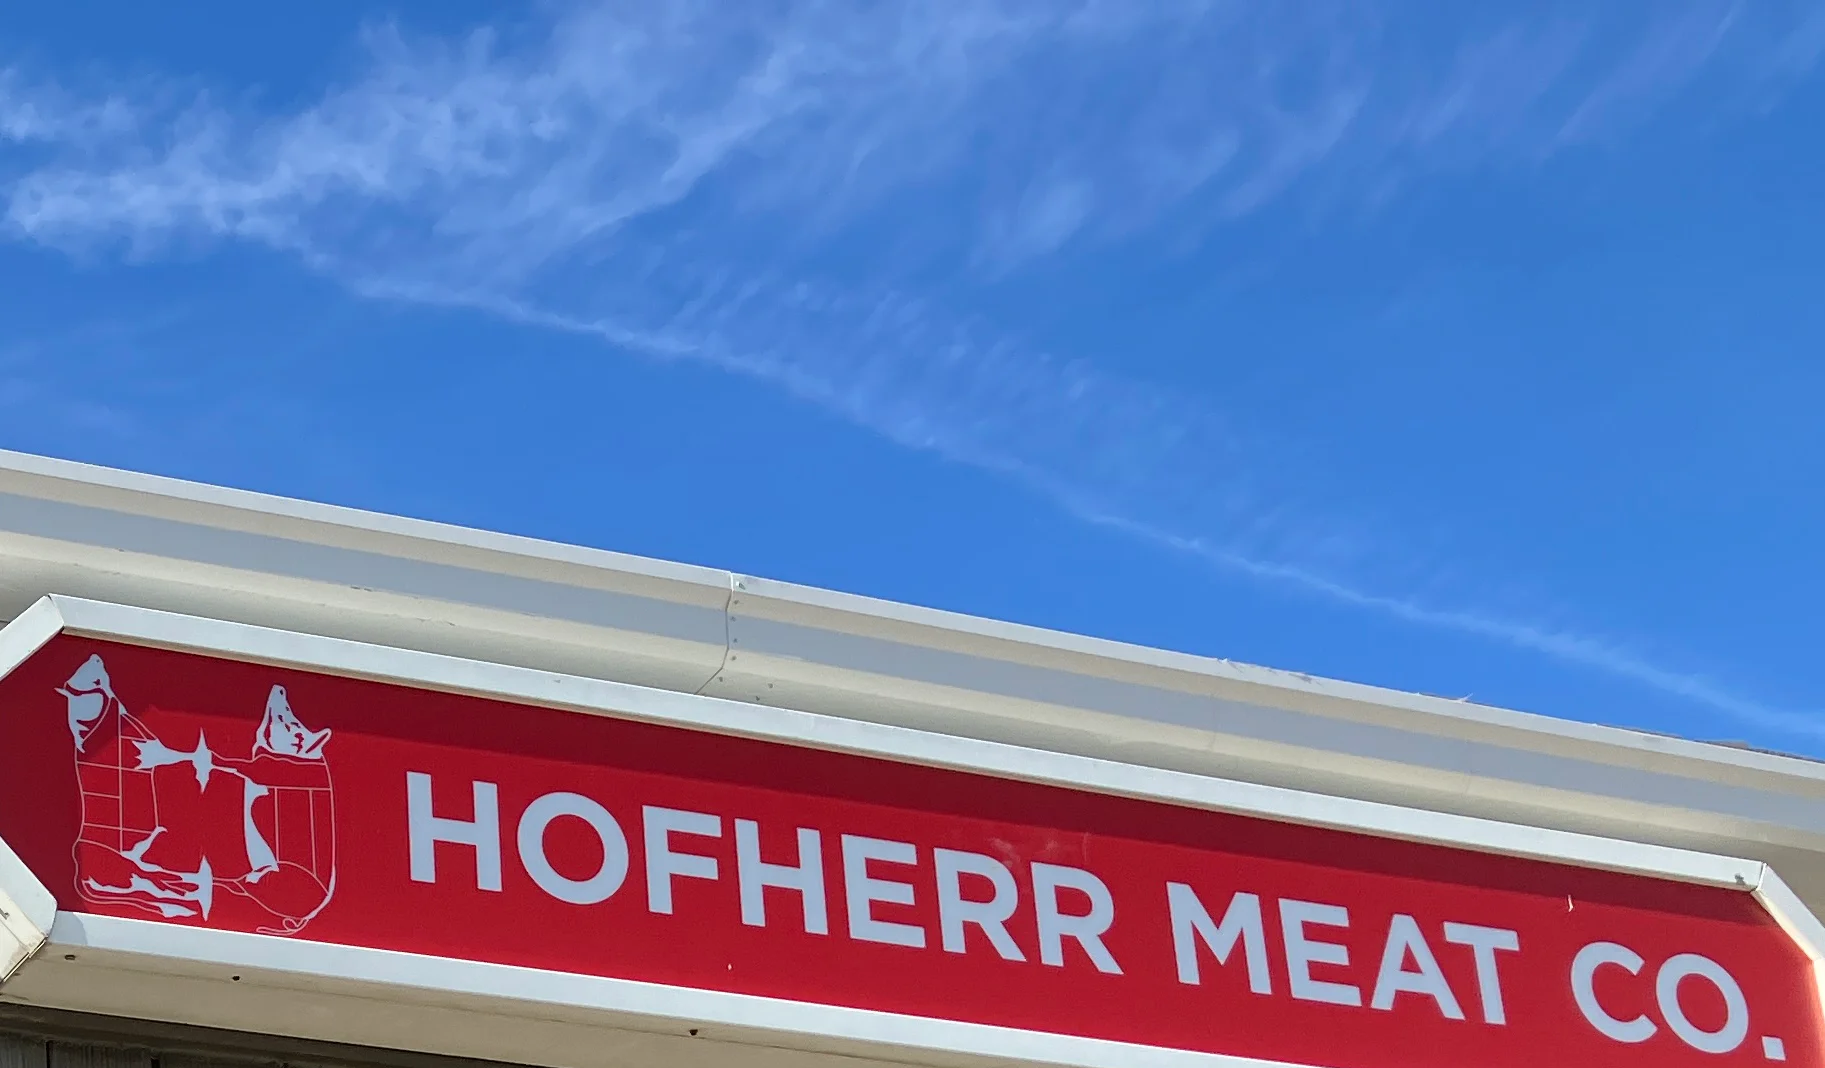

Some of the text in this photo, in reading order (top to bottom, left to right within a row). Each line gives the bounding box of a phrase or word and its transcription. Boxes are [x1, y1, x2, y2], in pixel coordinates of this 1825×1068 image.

[407, 772, 1785, 1060] HOFHERR MEAT CO.
